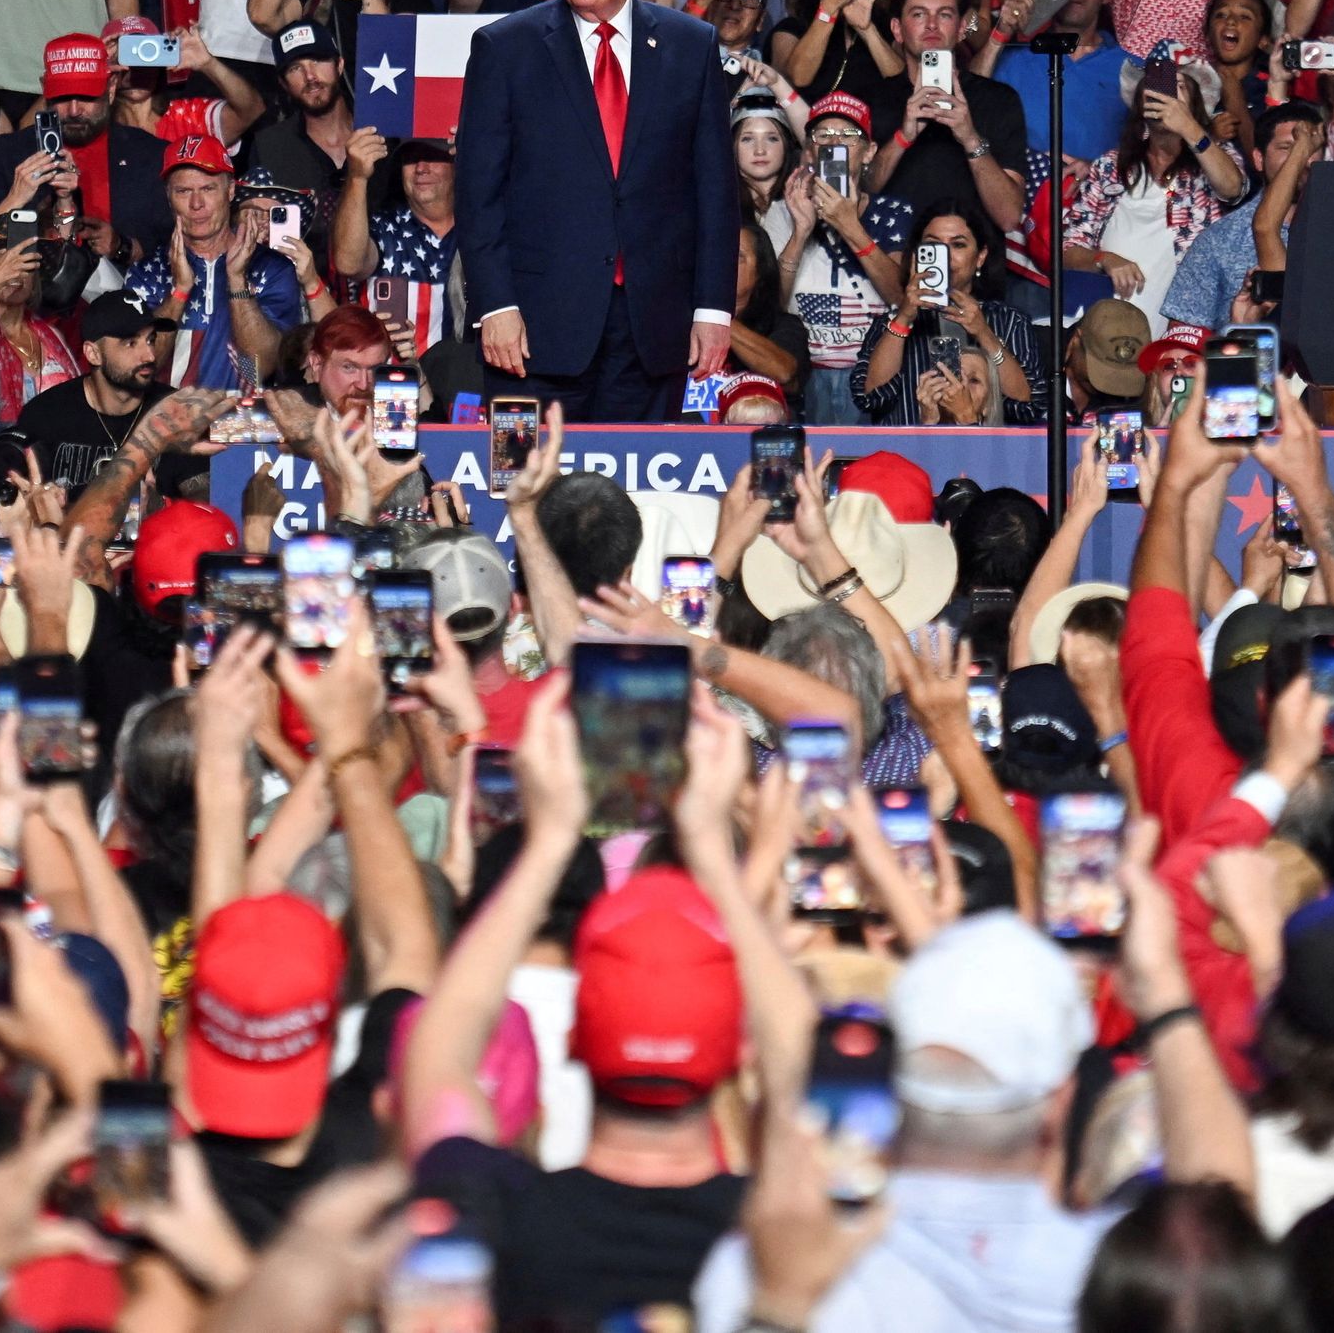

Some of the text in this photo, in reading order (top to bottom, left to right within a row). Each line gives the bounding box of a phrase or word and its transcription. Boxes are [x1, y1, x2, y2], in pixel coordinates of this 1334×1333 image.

[47, 48, 101, 62] MAKE AMERICA
[51, 62, 97, 74] GREAT AGAIN
[812, 95, 867, 112] MAKE AMERICA
[839, 106, 863, 117] AGAIN
[177, 134, 204, 159] 47
[742, 376, 777, 389] AMERICA
[1010, 715, 1050, 733] DONALD
